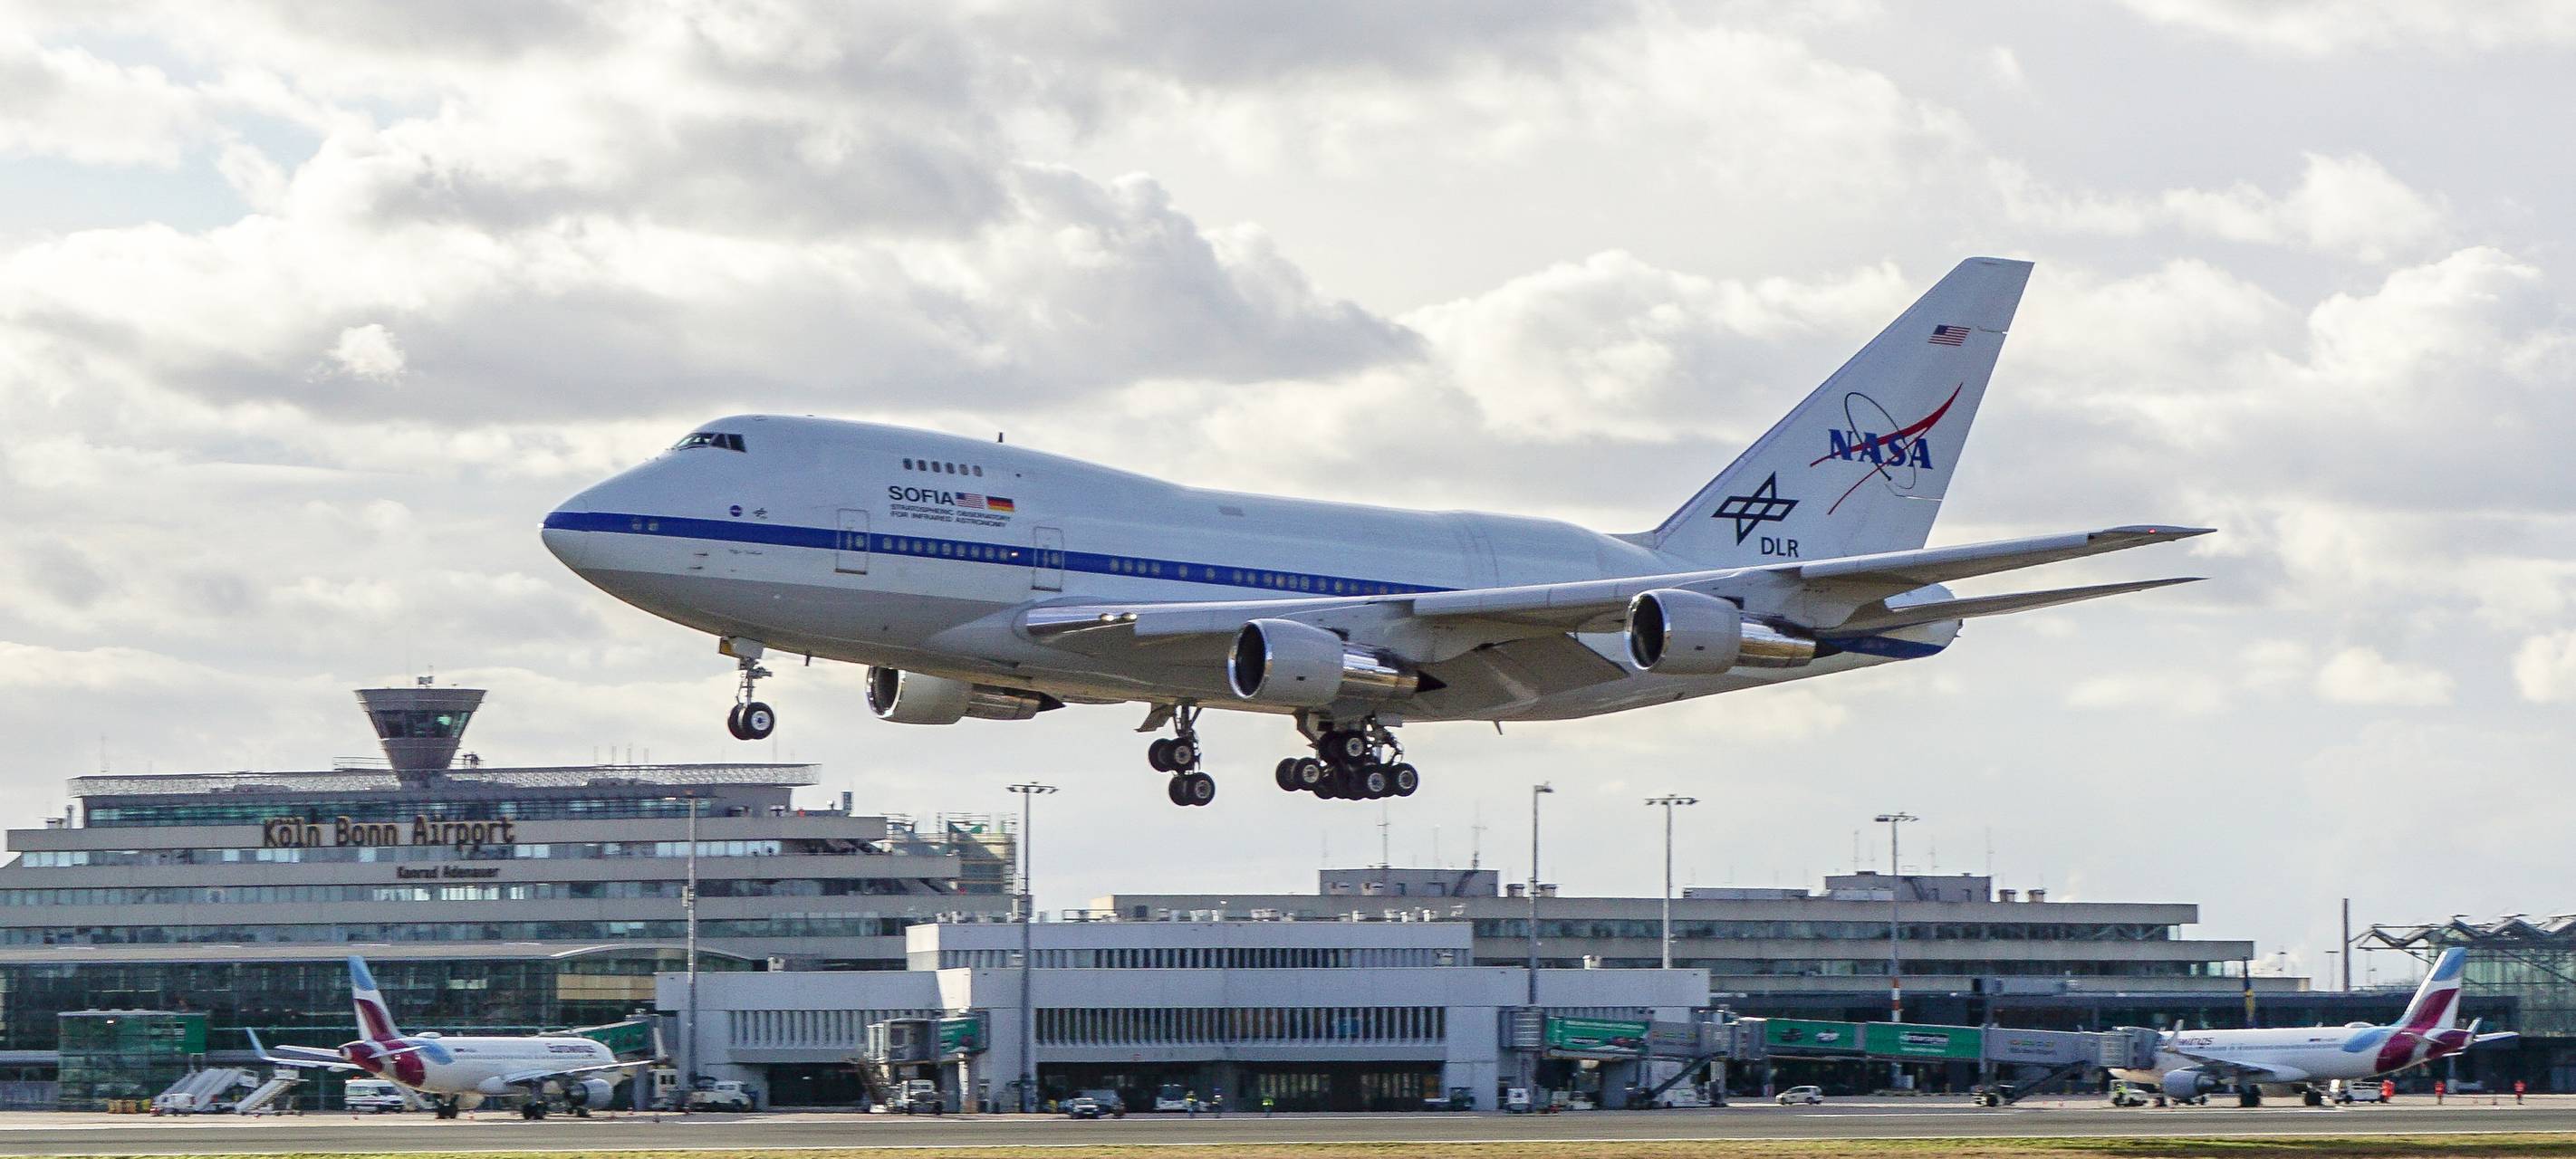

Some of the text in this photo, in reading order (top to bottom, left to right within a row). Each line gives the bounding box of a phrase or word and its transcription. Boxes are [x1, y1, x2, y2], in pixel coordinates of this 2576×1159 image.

[1828, 428, 1933, 470] NASA
[889, 485, 956, 506] SOFIA
[890, 503, 954, 516] STRATOSPHERIC
[911, 512, 954, 522] INFRARED
[1760, 537, 1799, 558] DLR
[263, 815, 515, 851] Köln Bonn Airport
